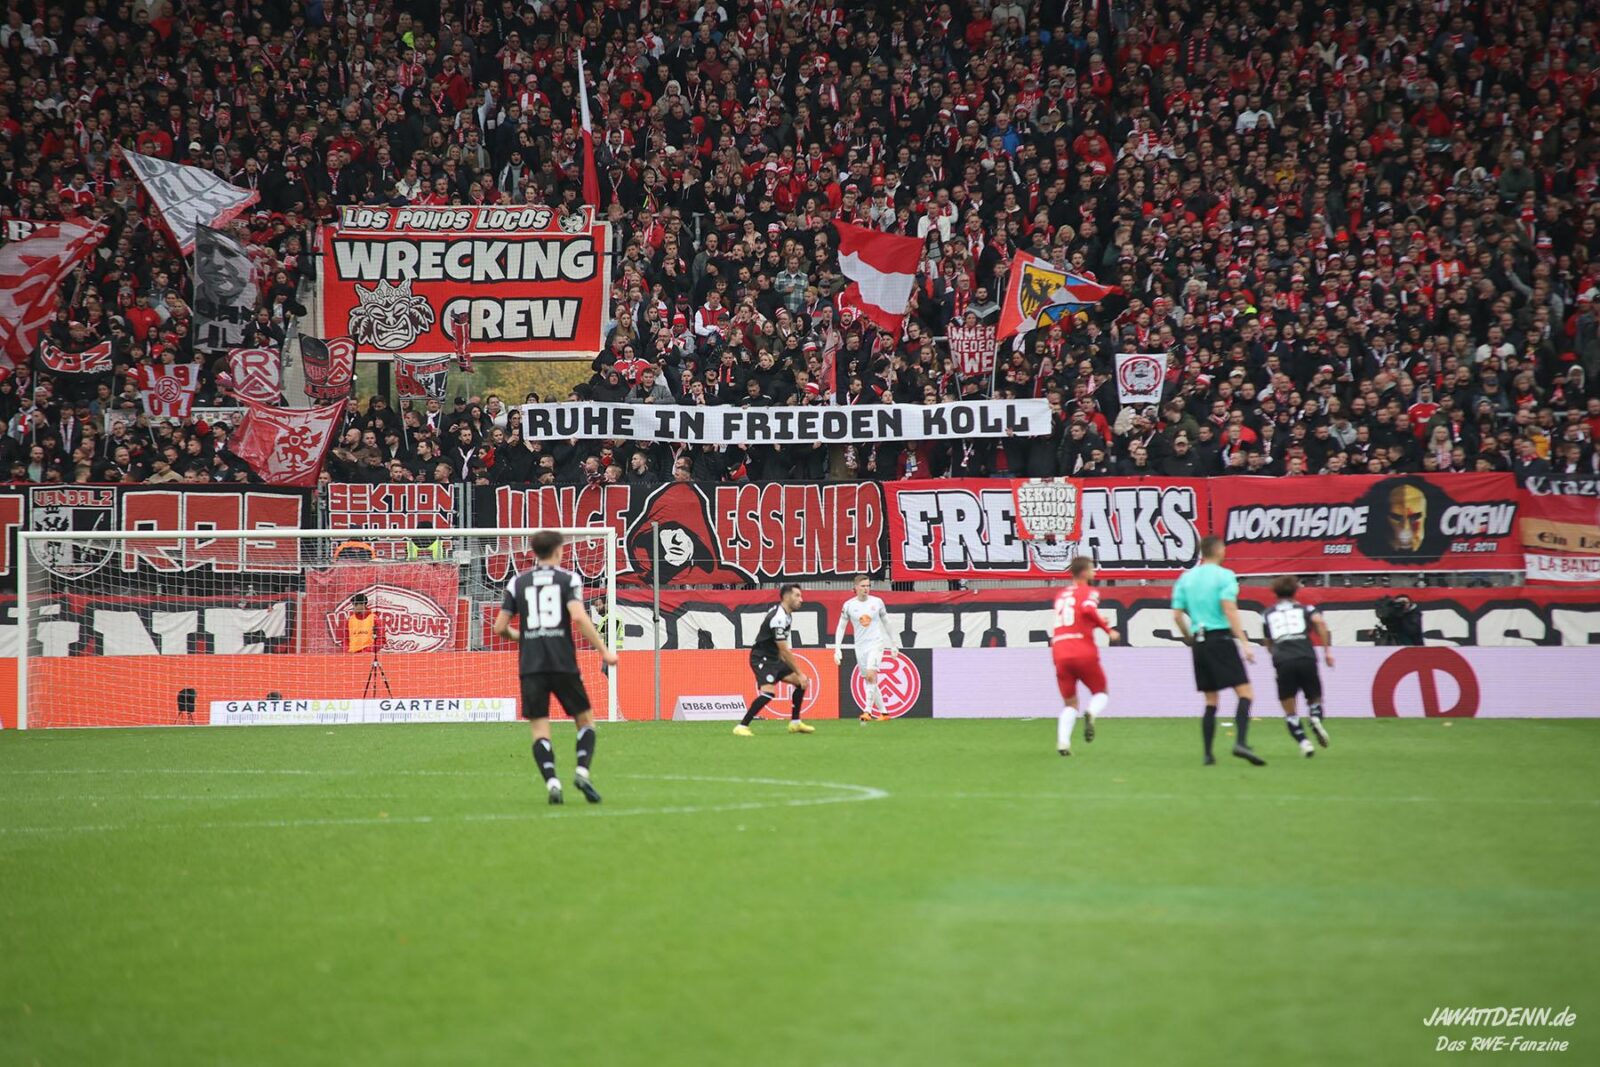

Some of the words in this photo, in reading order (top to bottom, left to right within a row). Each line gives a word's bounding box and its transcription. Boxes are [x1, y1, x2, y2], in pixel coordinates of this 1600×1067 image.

[343, 209, 388, 228] LOS
[475, 209, 550, 231] LOCOS
[334, 240, 594, 279] WRECKING
[441, 299, 579, 340] CREW
[527, 407, 635, 437] RUHE
[654, 410, 705, 440] IN
[722, 407, 903, 440] FRIEDEN
[922, 404, 1030, 436] KOLL
[34, 489, 113, 507] VANDALZ
[328, 483, 455, 512] SEKTION
[1018, 487, 1077, 503] SEKTION
[1019, 502, 1076, 517] STADION
[485, 484, 634, 582] JUNGE
[715, 481, 884, 578] ESSENER
[1024, 517, 1074, 532] VERBOT
[1226, 505, 1370, 541] NORTHSIDE
[1440, 504, 1516, 536] CREW
[524, 584, 562, 630] 19
[693, 703, 714, 711] B&B
[715, 701, 746, 710] GmbH
